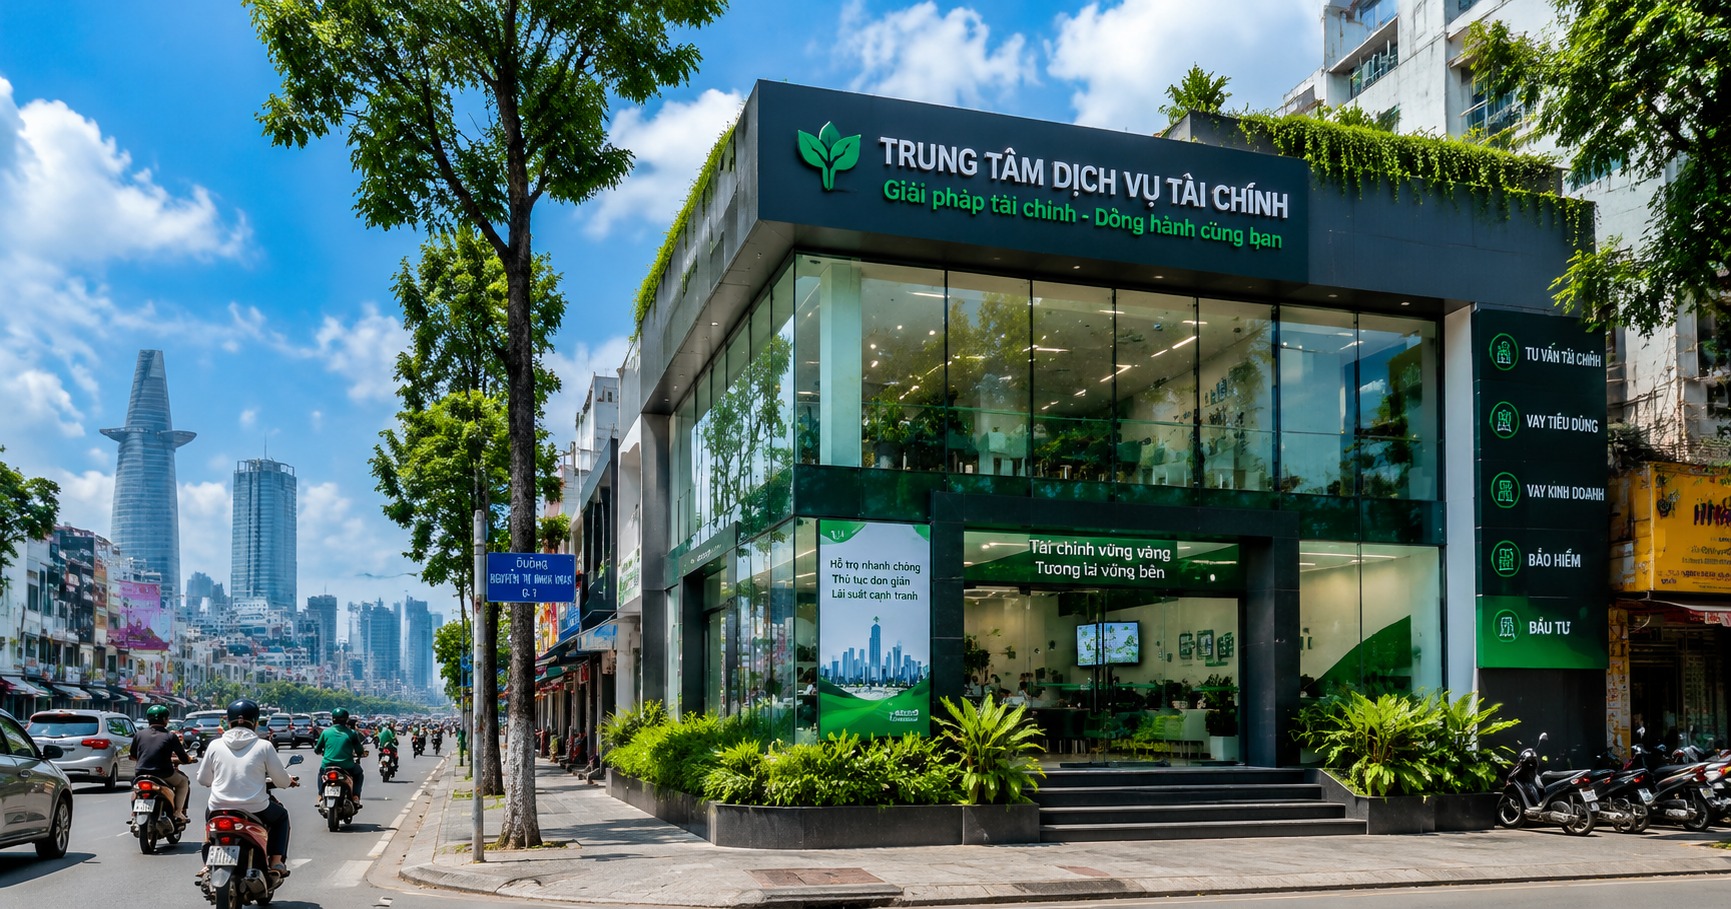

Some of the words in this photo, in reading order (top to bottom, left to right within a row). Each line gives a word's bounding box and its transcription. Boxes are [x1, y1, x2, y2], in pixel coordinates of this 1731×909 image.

[879, 136, 978, 177] TRUNG
[984, 147, 1045, 187] TÂM
[1052, 160, 1117, 198] DỊCH
[1123, 171, 1161, 208] VỤ
[1213, 182, 1289, 219] CHÍNH
[1526, 414, 1546, 429] VAY
[1526, 484, 1546, 498] VAY
[862, 560, 890, 571] nhanh
[895, 591, 918, 601] tranh
